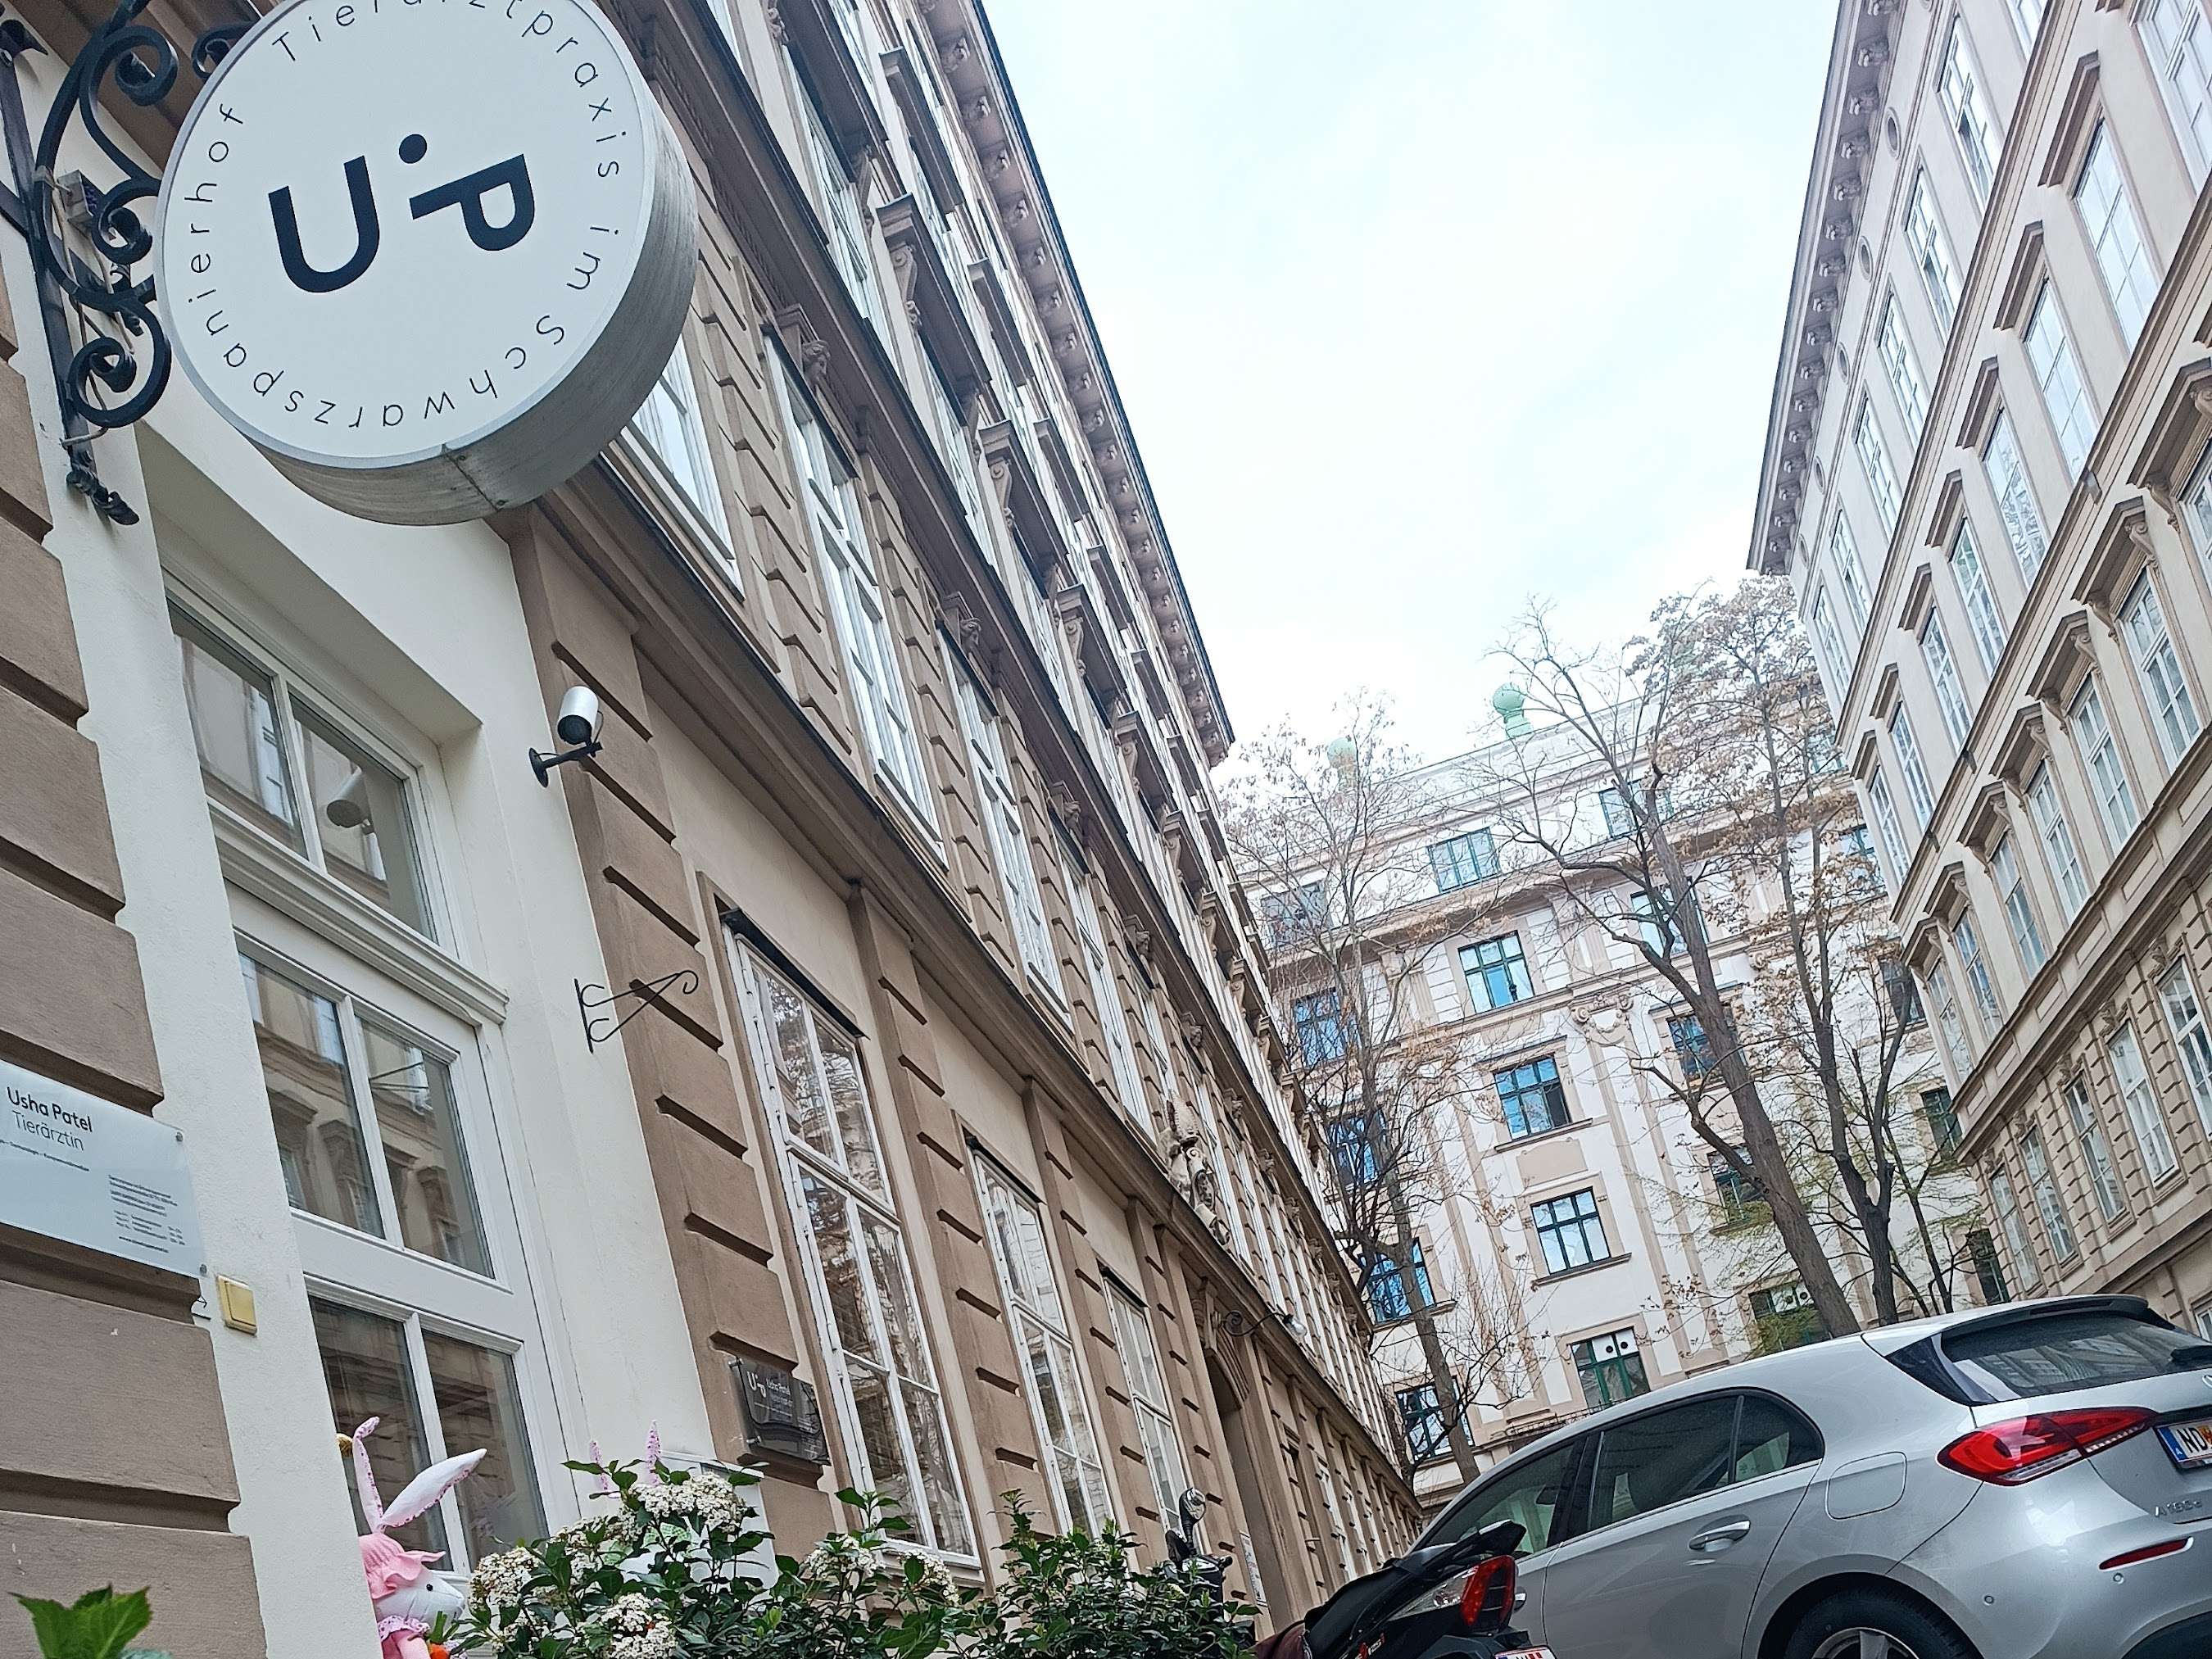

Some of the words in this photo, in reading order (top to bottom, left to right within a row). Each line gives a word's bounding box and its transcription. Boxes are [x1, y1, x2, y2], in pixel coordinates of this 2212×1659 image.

[184, 103, 565, 428] Schwarzspanierhof
[566, 226, 619, 290] im
[7, 1086, 49, 1117] Usha
[52, 1103, 93, 1132] Patel
[11, 1110, 84, 1151] Tierärztin
